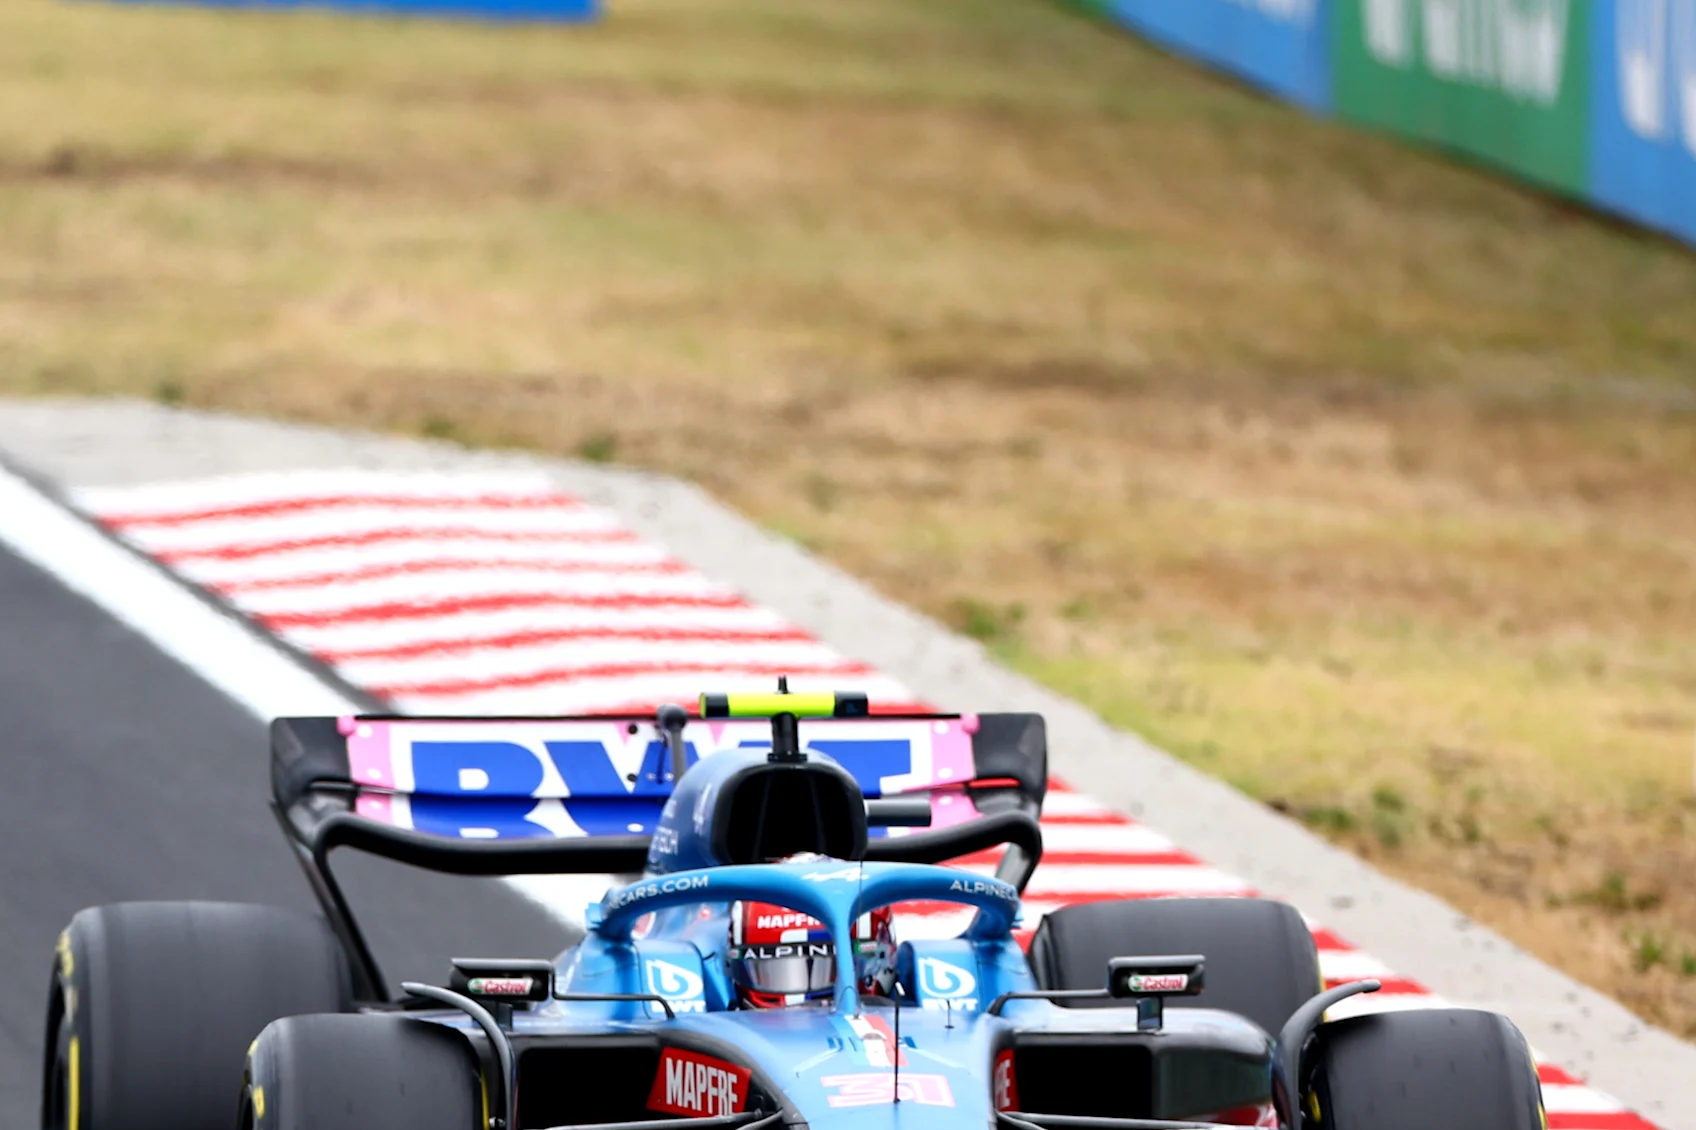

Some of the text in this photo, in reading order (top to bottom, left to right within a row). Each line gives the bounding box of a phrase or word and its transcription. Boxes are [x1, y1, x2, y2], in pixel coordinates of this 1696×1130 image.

[744, 944, 836, 959] ALPIN
[483, 977, 529, 994] Castrol
[1142, 975, 1185, 990] Castrol
[665, 1057, 739, 1117] MAPFRE
